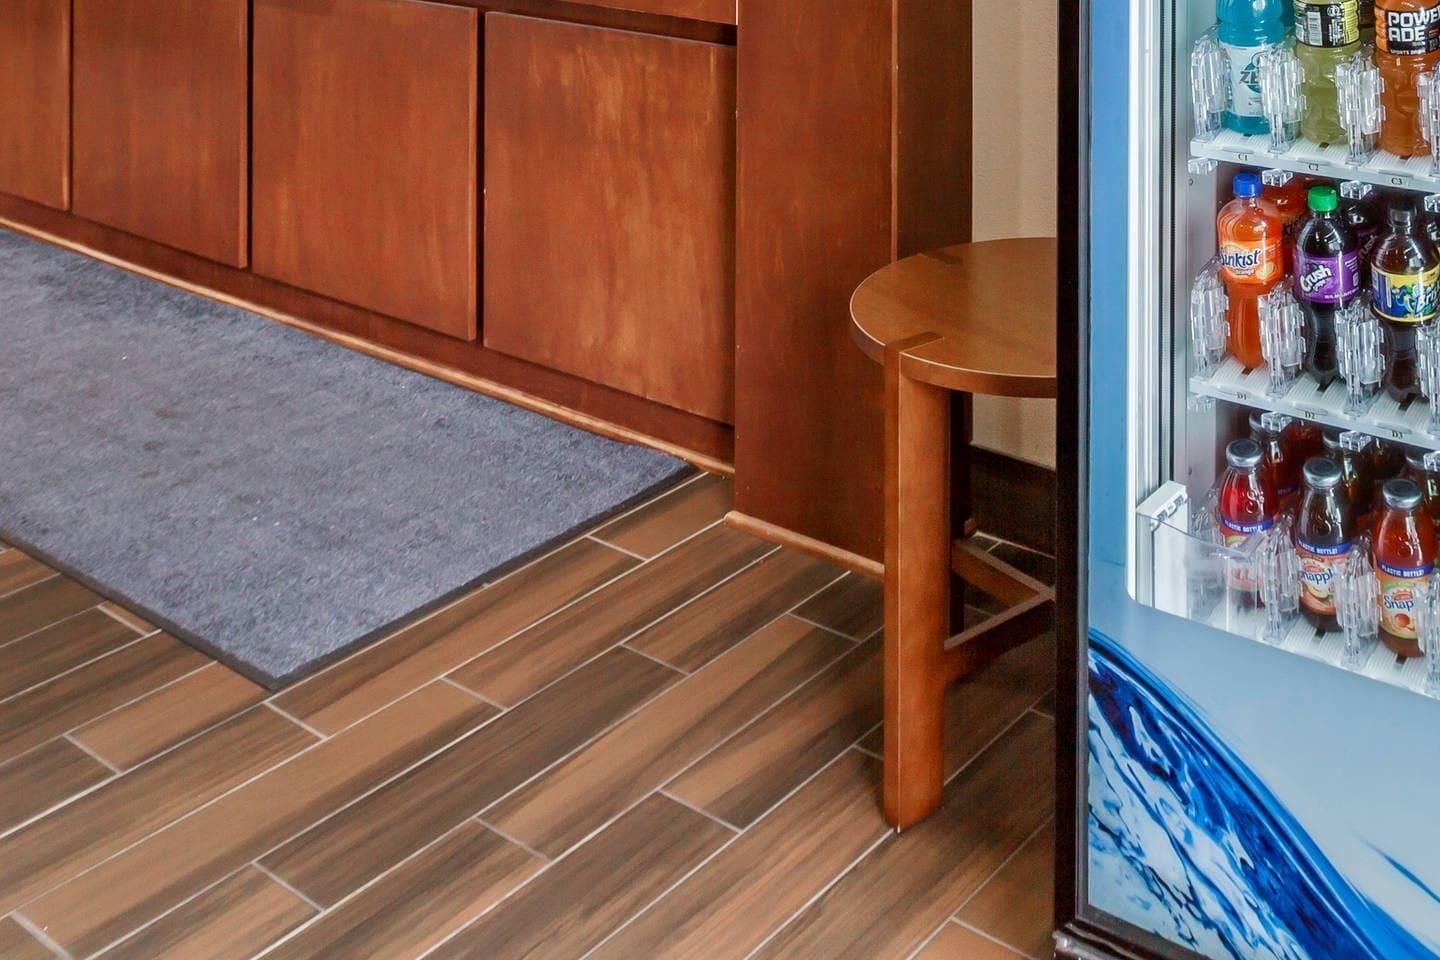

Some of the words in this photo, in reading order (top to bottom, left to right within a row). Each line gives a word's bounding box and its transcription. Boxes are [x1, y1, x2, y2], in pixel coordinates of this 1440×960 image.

[1388, 26, 1426, 42] ADE
[1238, 154, 1248, 162] C1
[1300, 264, 1332, 292] Crush
[1304, 412, 1315, 420] D2
[1392, 430, 1403, 438] D3
